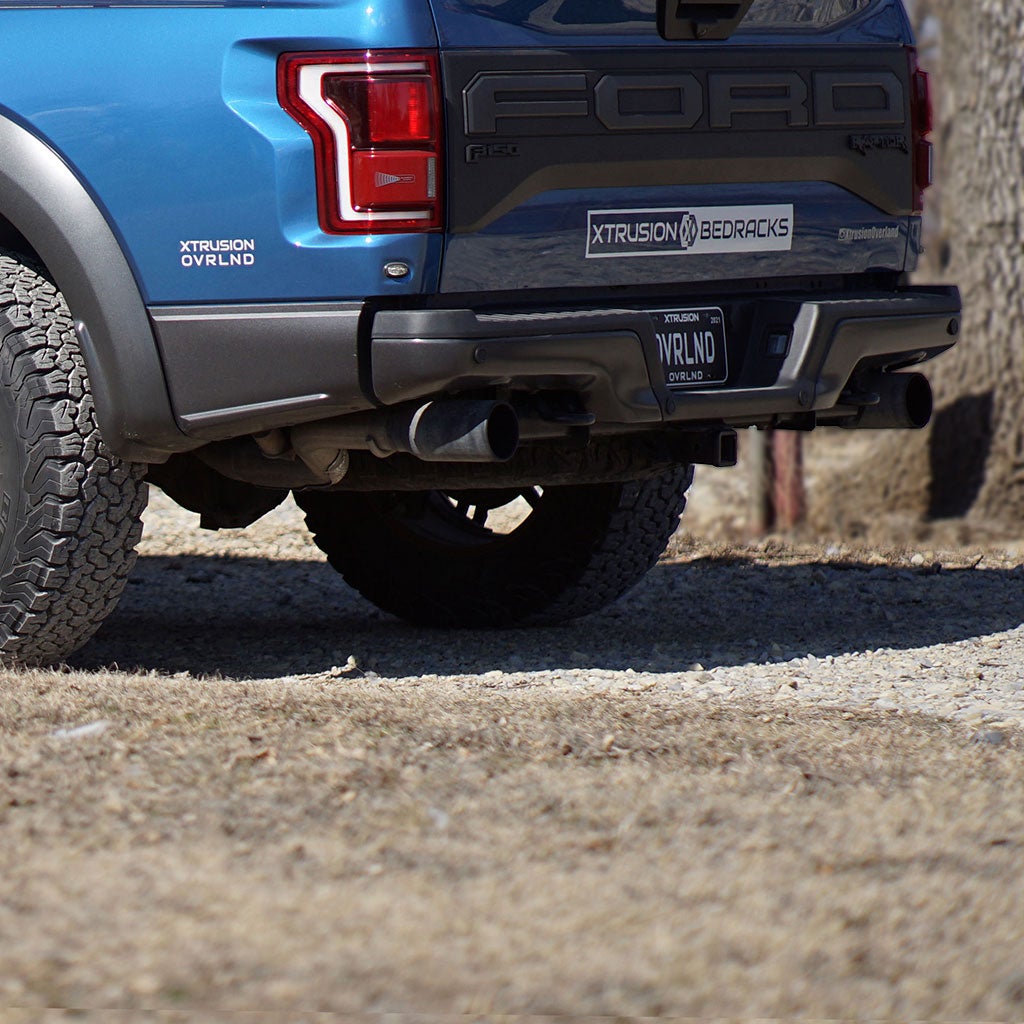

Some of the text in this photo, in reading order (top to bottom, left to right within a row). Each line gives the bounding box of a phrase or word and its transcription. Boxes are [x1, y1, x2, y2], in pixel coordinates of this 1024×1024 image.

[461, 69, 906, 137] FORD
[591, 220, 677, 244] XTRUSION
[700, 217, 789, 240] BEDRACKS
[179, 238, 255, 252] XTRUSION
[181, 253, 255, 267] OVRLND
[663, 312, 700, 324] XTRUSION
[668, 370, 703, 382] OVRLND
